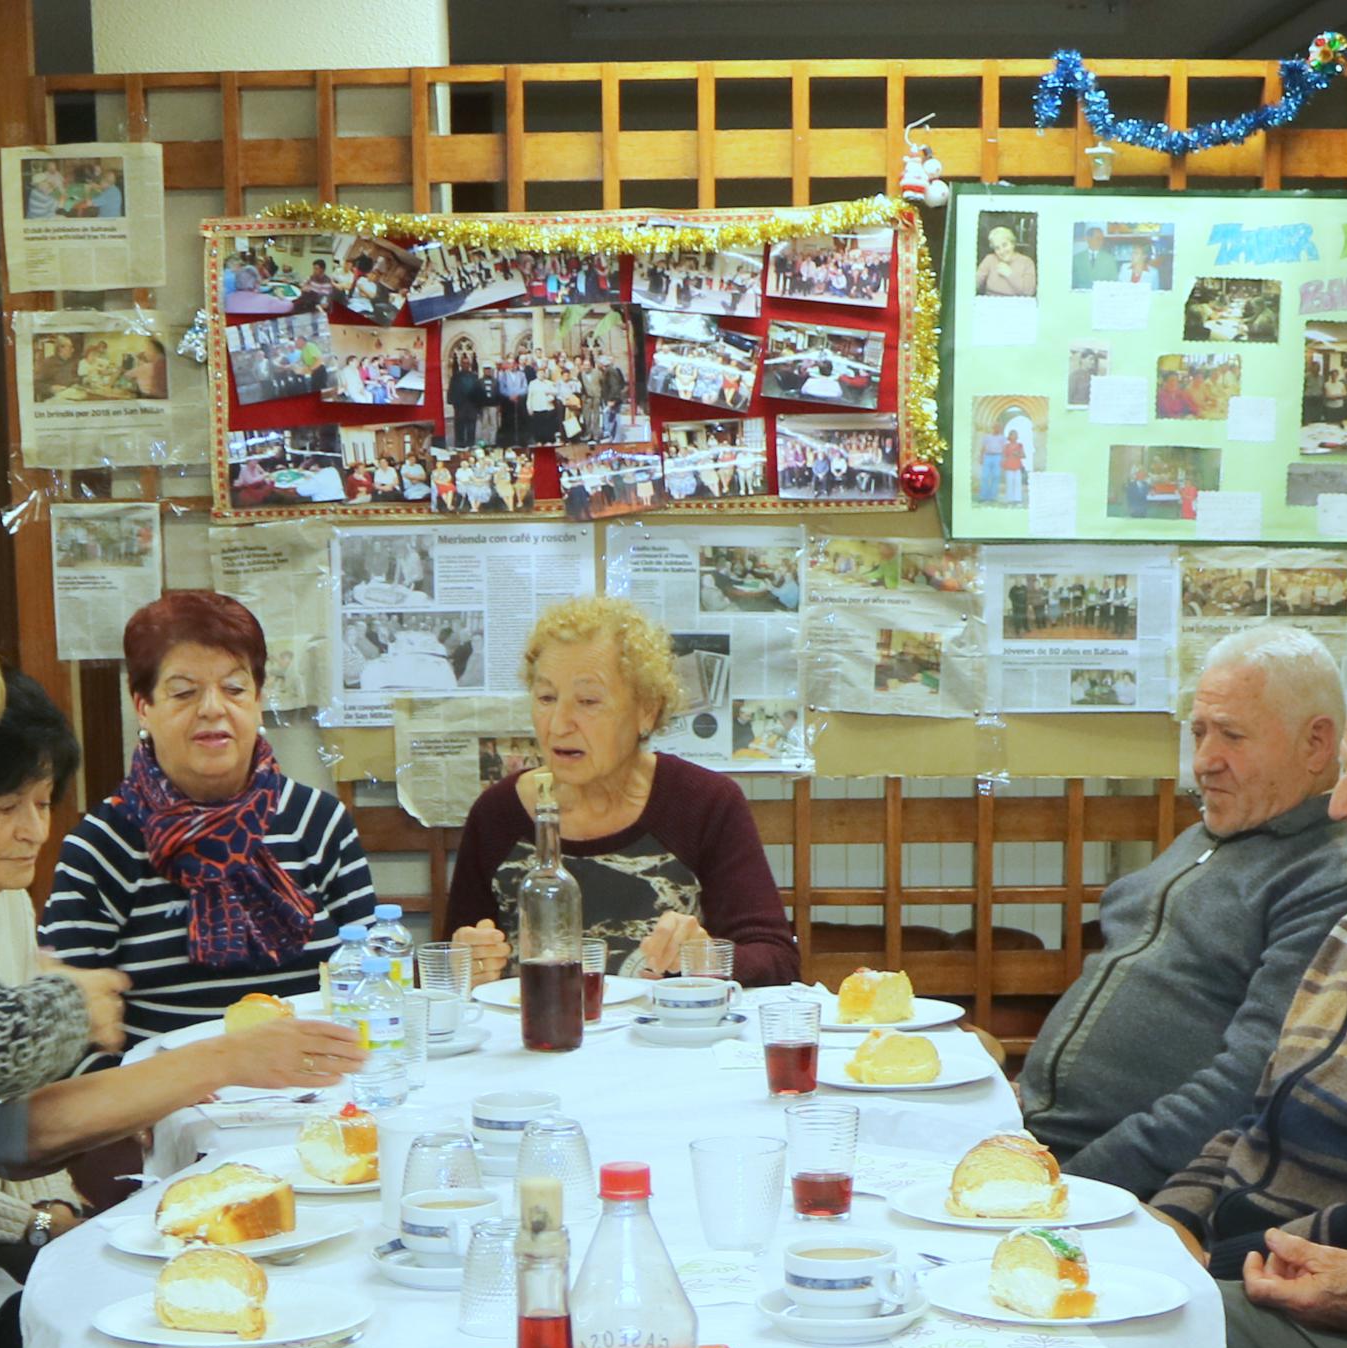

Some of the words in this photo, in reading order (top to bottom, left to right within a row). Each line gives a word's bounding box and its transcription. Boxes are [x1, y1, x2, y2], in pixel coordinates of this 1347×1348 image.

[46, 410, 74, 418] brindis
[76, 410, 89, 419] por
[91, 408, 110, 417] 2018
[124, 407, 138, 415] San
[140, 406, 164, 414] Millán
[438, 534, 486, 544] Merienda
[489, 535, 508, 543] con
[510, 533, 530, 543] café
[533, 535, 540, 544] y
[542, 532, 577, 543] roscón
[1003, 648, 1035, 656] Jóvenes
[1062, 648, 1080, 656] años
[1094, 647, 1129, 656] Baltanás
